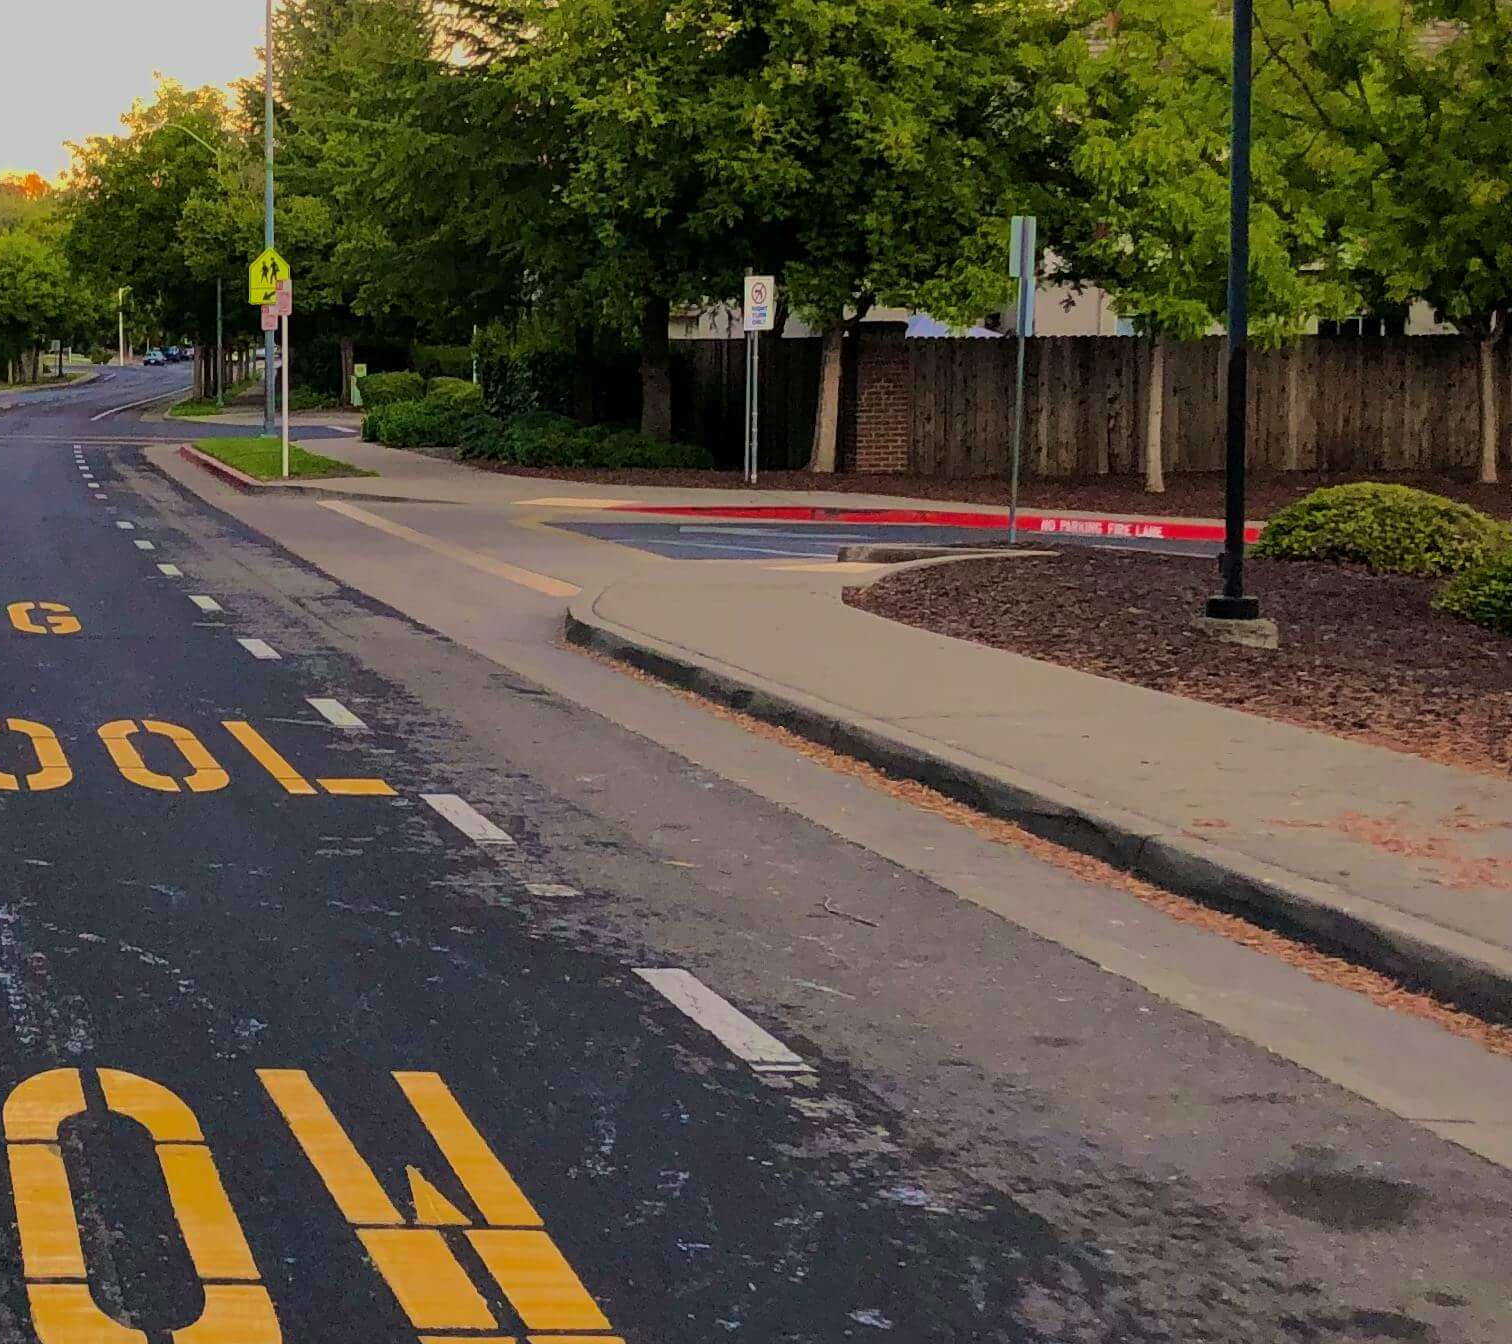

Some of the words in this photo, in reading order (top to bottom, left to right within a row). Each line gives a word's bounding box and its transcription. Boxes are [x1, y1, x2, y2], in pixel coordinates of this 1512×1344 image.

[1040, 519, 1056, 532] NO
[1059, 519, 1103, 535] PARKING
[1107, 522, 1133, 536] FIRE
[1135, 524, 1164, 538] LANE
